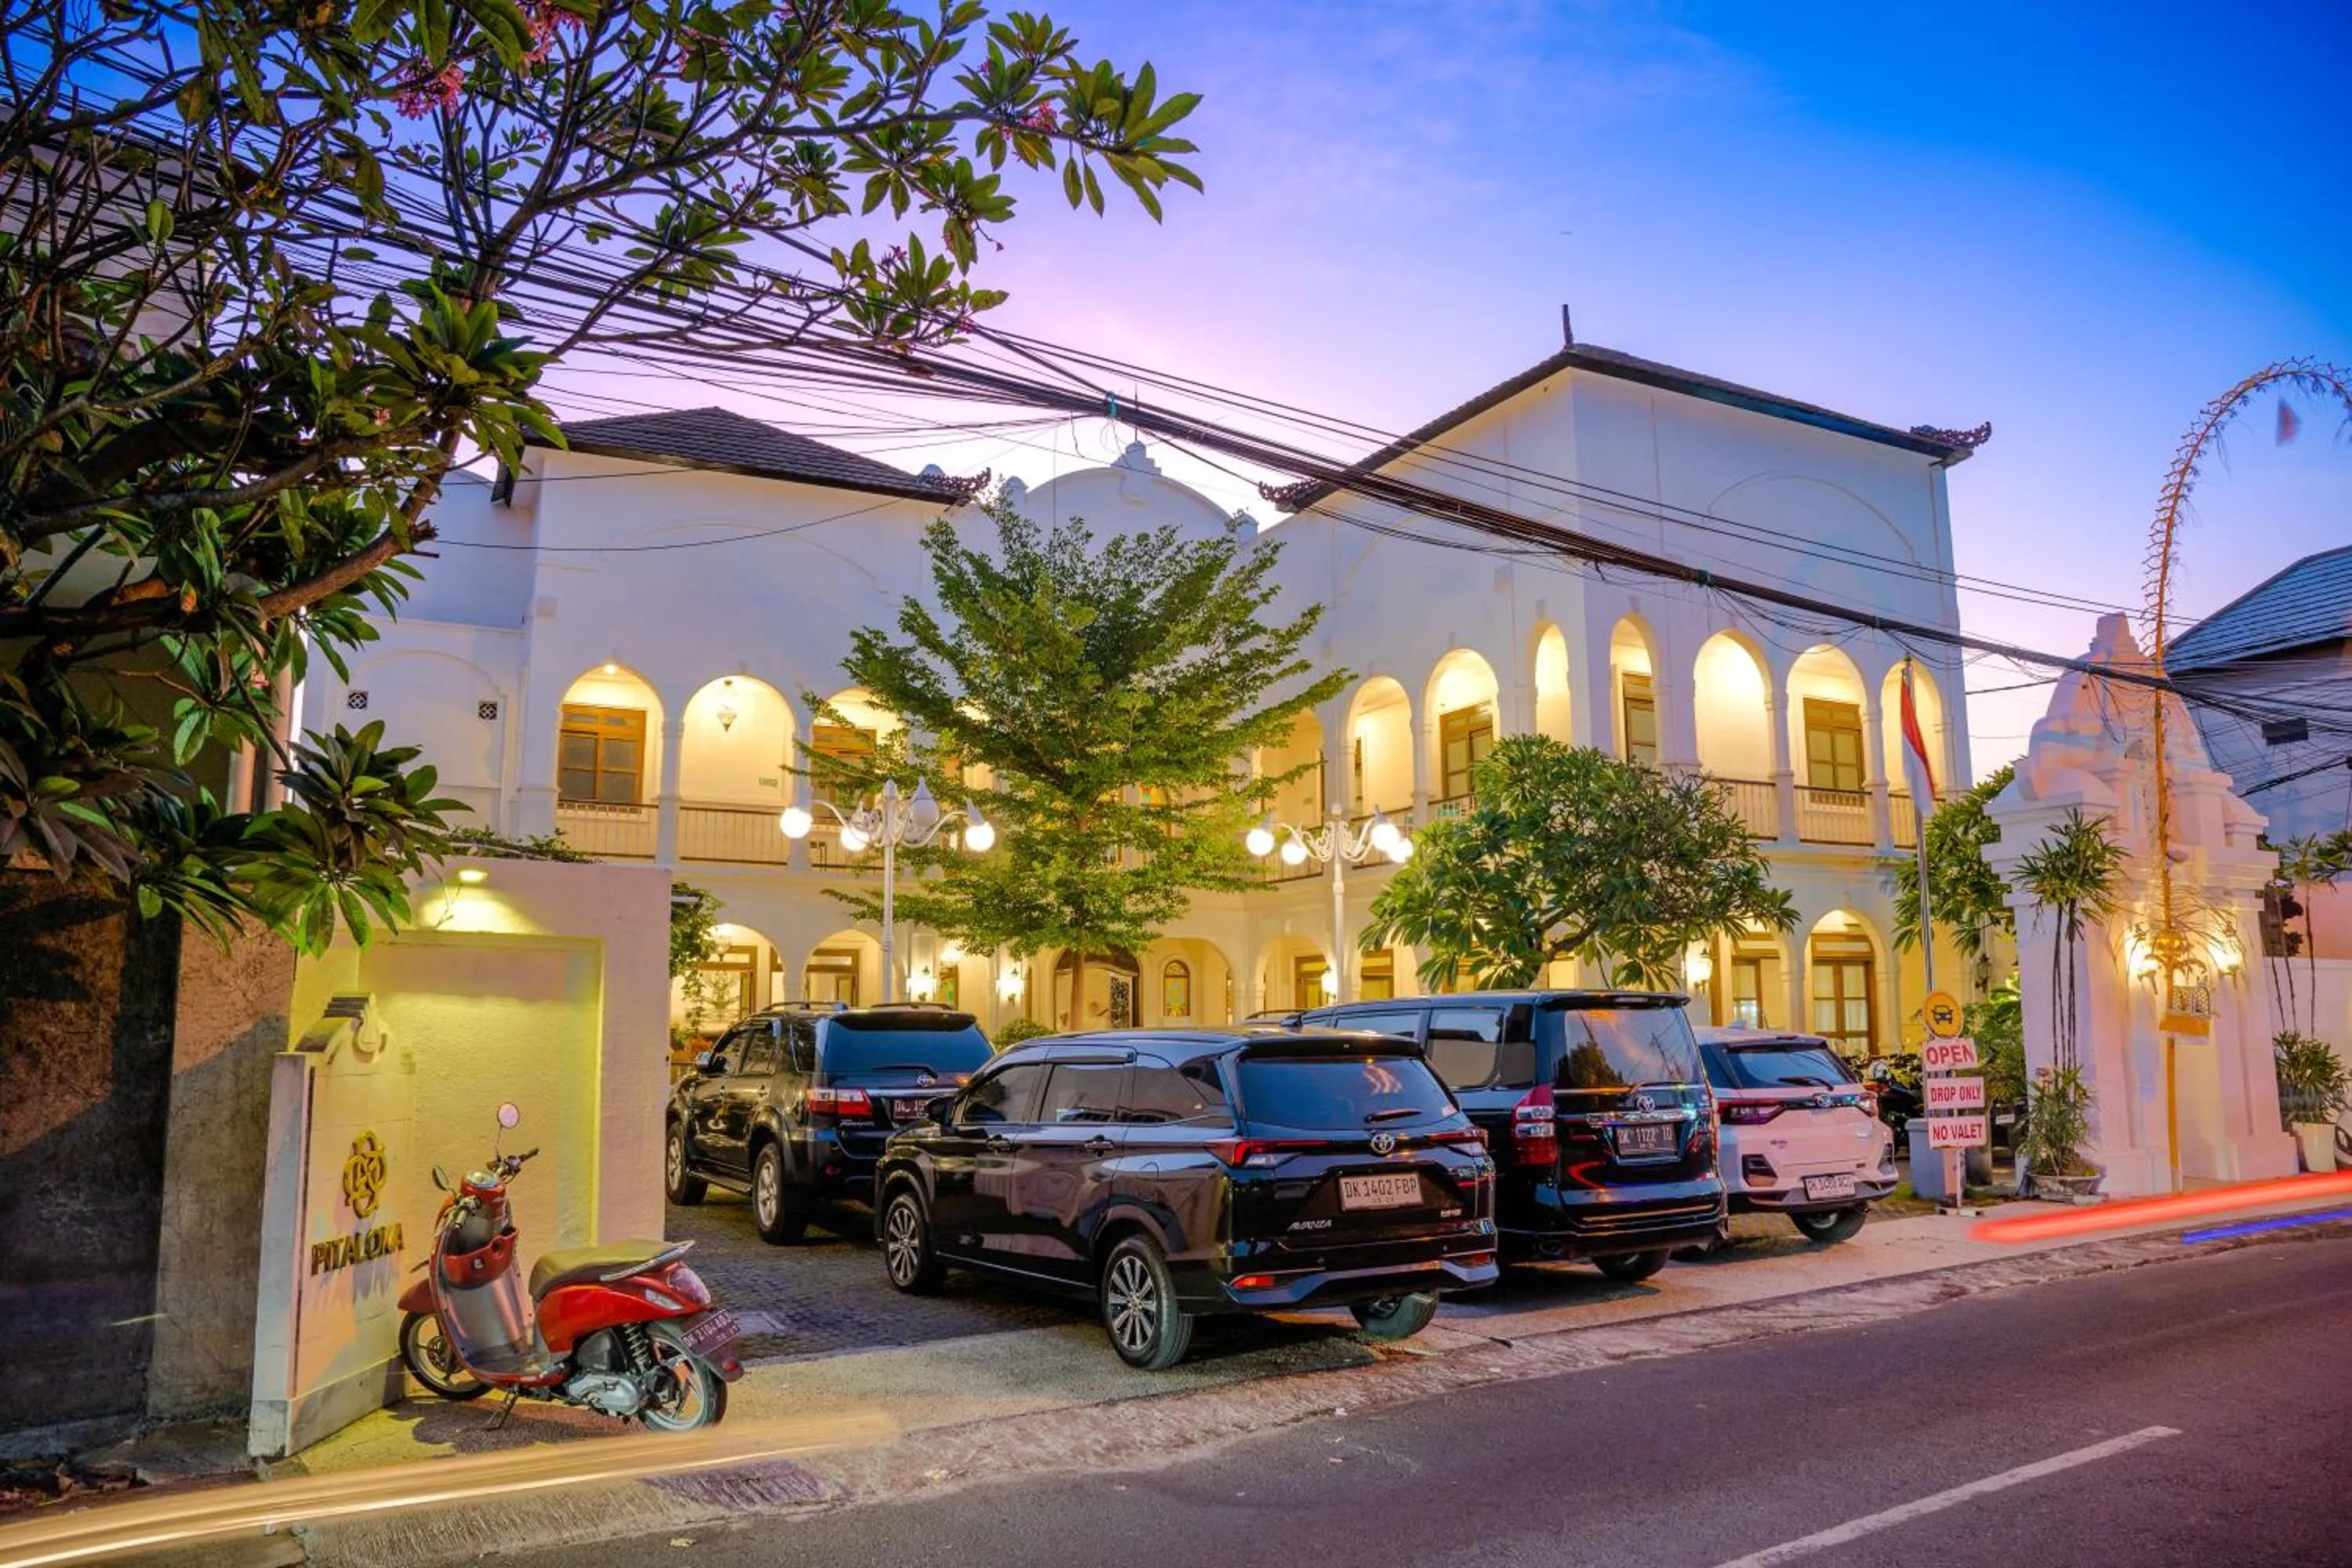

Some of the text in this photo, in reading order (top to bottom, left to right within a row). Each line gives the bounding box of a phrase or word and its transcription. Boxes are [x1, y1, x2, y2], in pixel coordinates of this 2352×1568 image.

[1926, 1044, 1974, 1065] OPEN
[1931, 1084, 1981, 1102] DROP ONLY
[1933, 1123, 1983, 1141] NO VALET
[1344, 1178, 1417, 1198] DK 1402 FBP
[310, 1222, 404, 1276] PITALOKA
